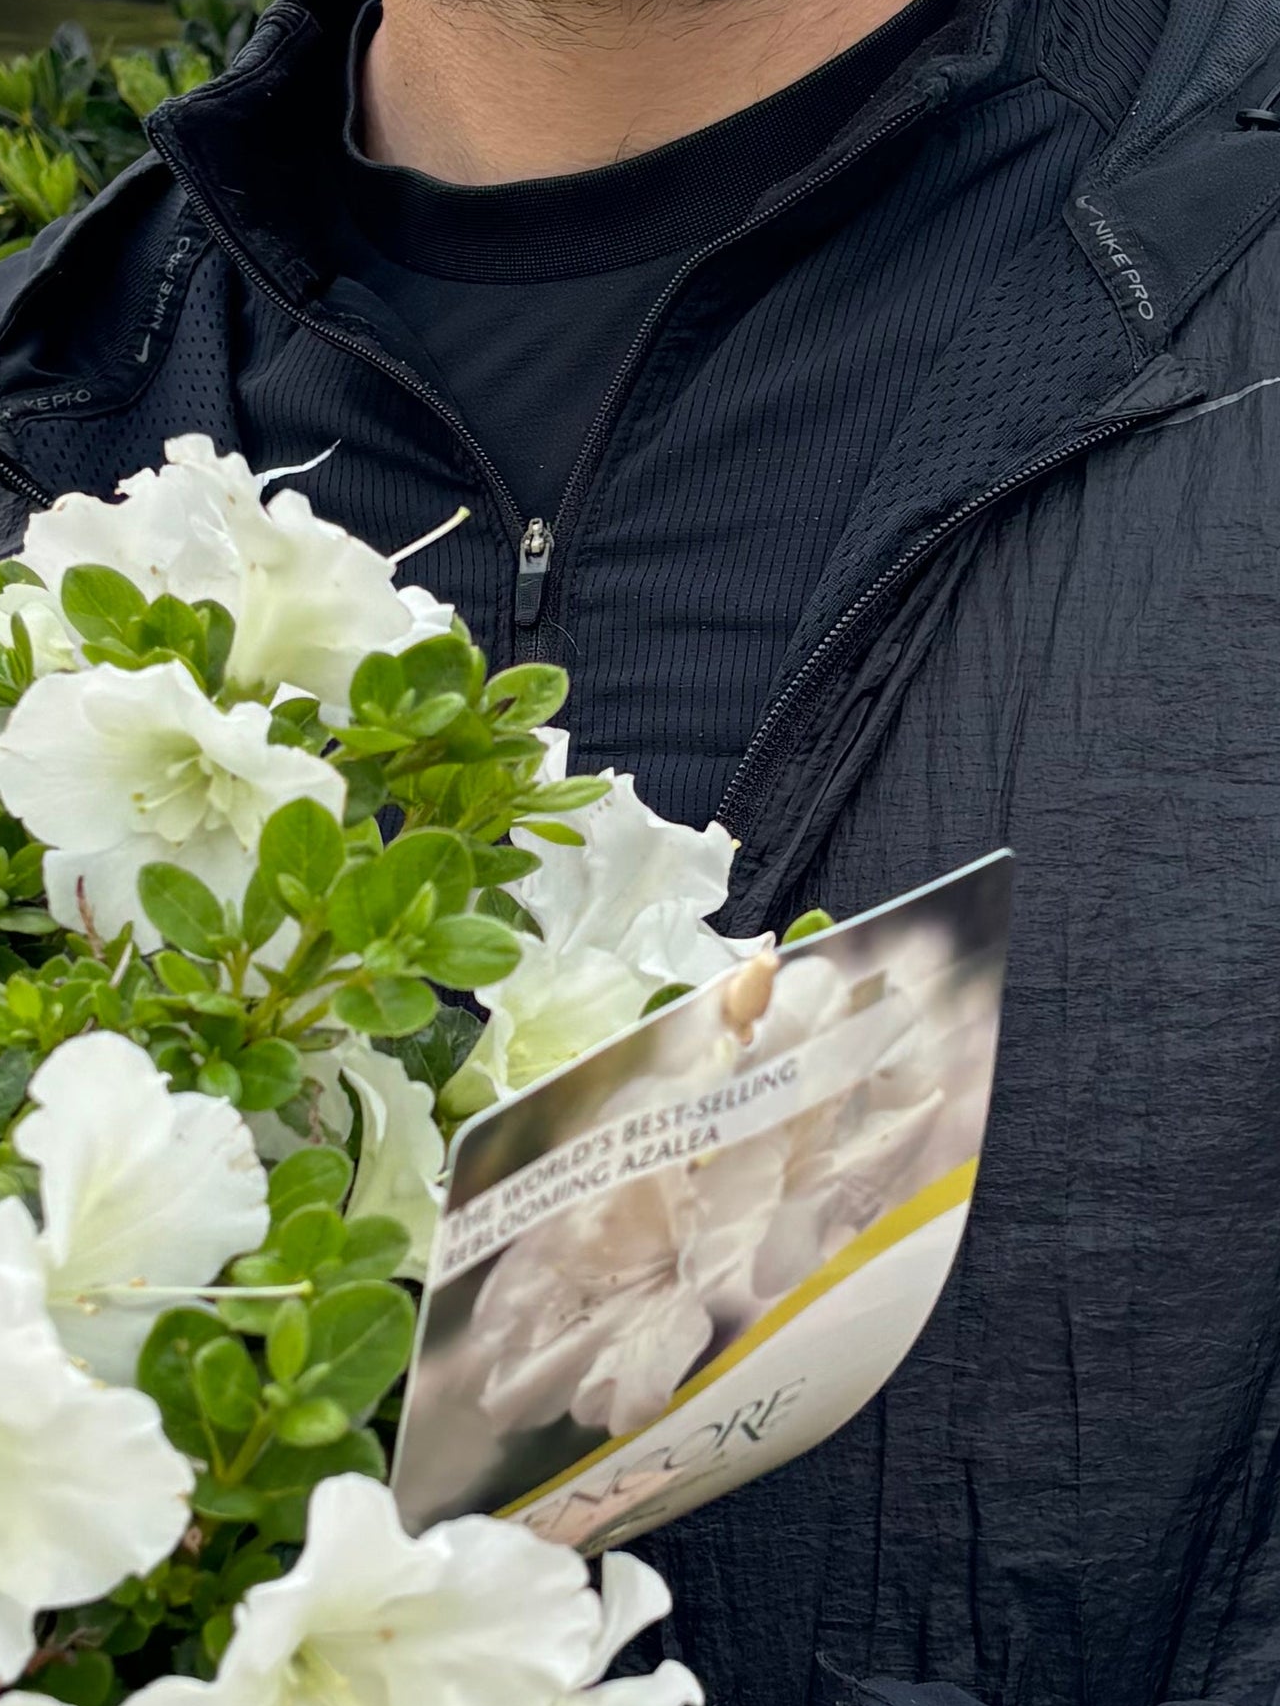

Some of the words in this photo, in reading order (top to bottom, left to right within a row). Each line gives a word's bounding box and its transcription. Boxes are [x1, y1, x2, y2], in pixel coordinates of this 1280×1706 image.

[1089, 219, 1133, 268] NIKE
[1121, 268, 1154, 321] PRO
[150, 279, 175, 330] NIKE
[622, 1057, 801, 1142] BEST-SELLING
[620, 1127, 721, 1176] AZALEA
